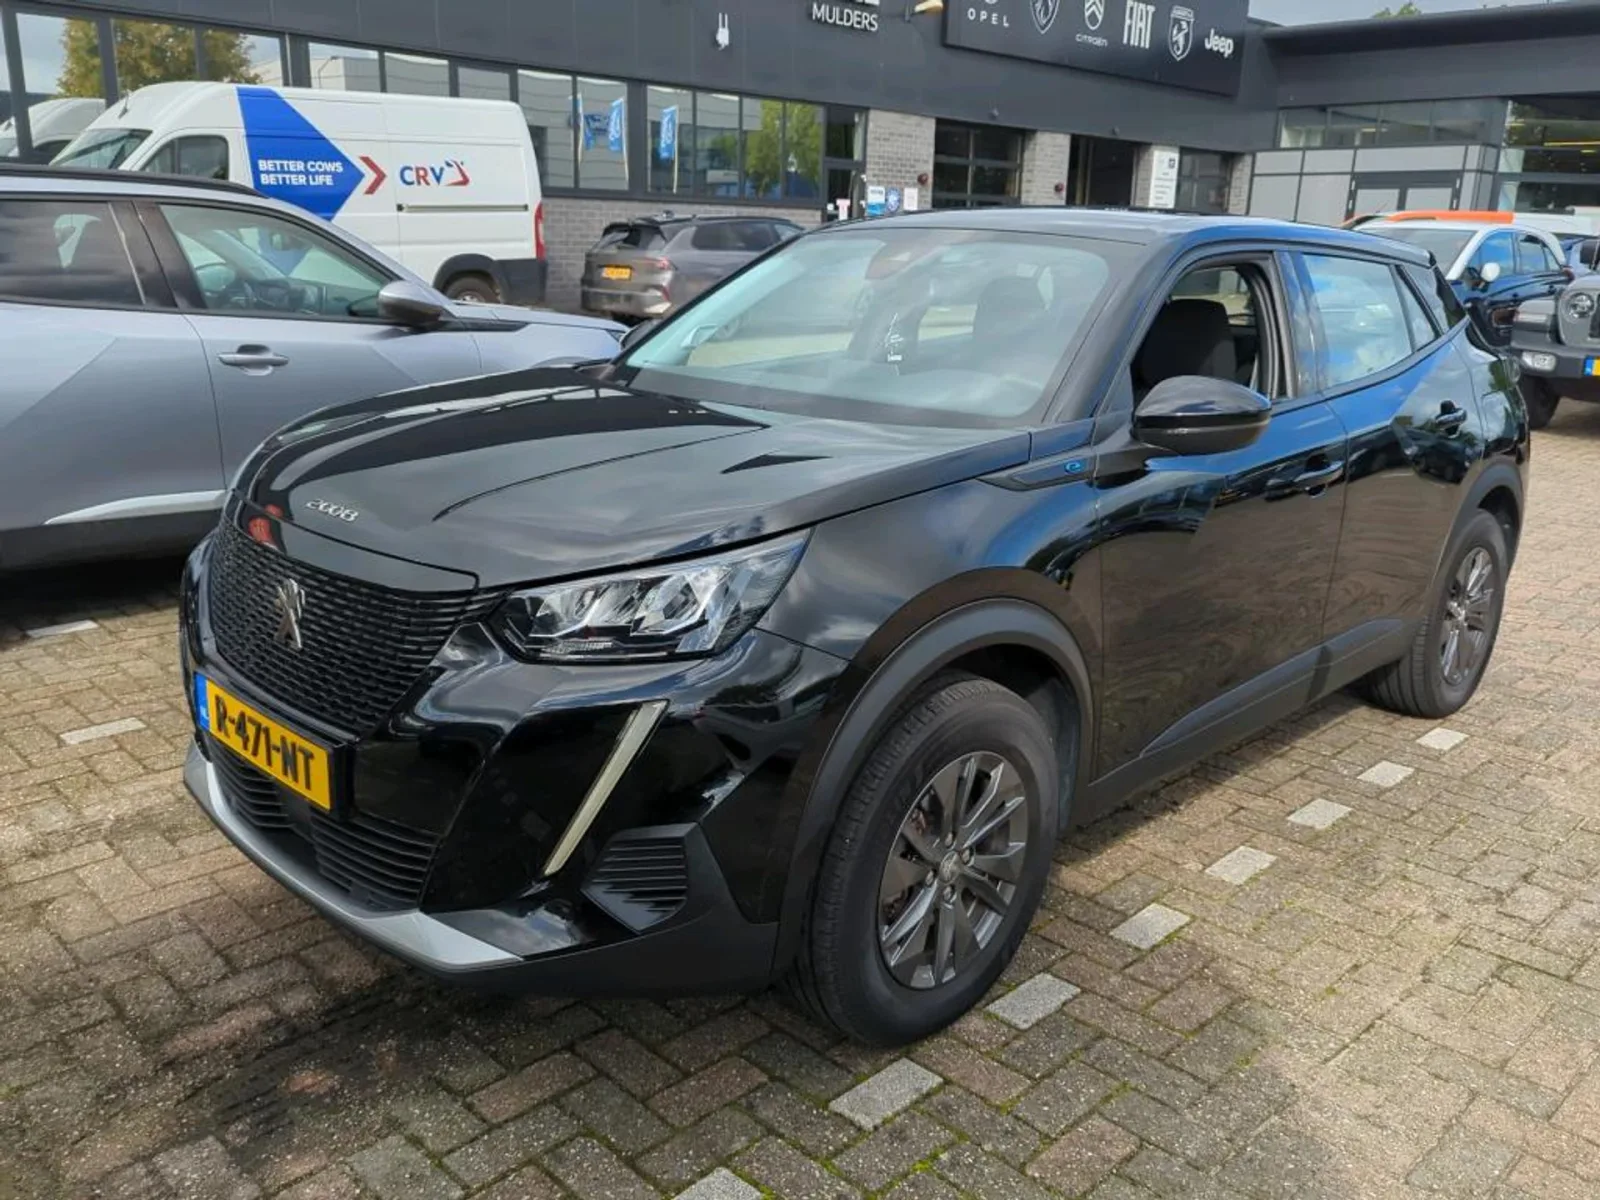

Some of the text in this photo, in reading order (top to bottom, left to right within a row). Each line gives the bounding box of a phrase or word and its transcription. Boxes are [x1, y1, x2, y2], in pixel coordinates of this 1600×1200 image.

[812, 2, 879, 32] MULDERS
[967, 7, 1010, 28] OPEL
[1123, 0, 1156, 49] FIAT
[1204, 28, 1234, 57] Jeep
[258, 160, 344, 173] BETTER COWS
[400, 165, 444, 186] CRV
[261, 173, 334, 186] BETTER LIFE
[306, 498, 359, 521] 2008
[214, 693, 316, 791] R-471-NT
